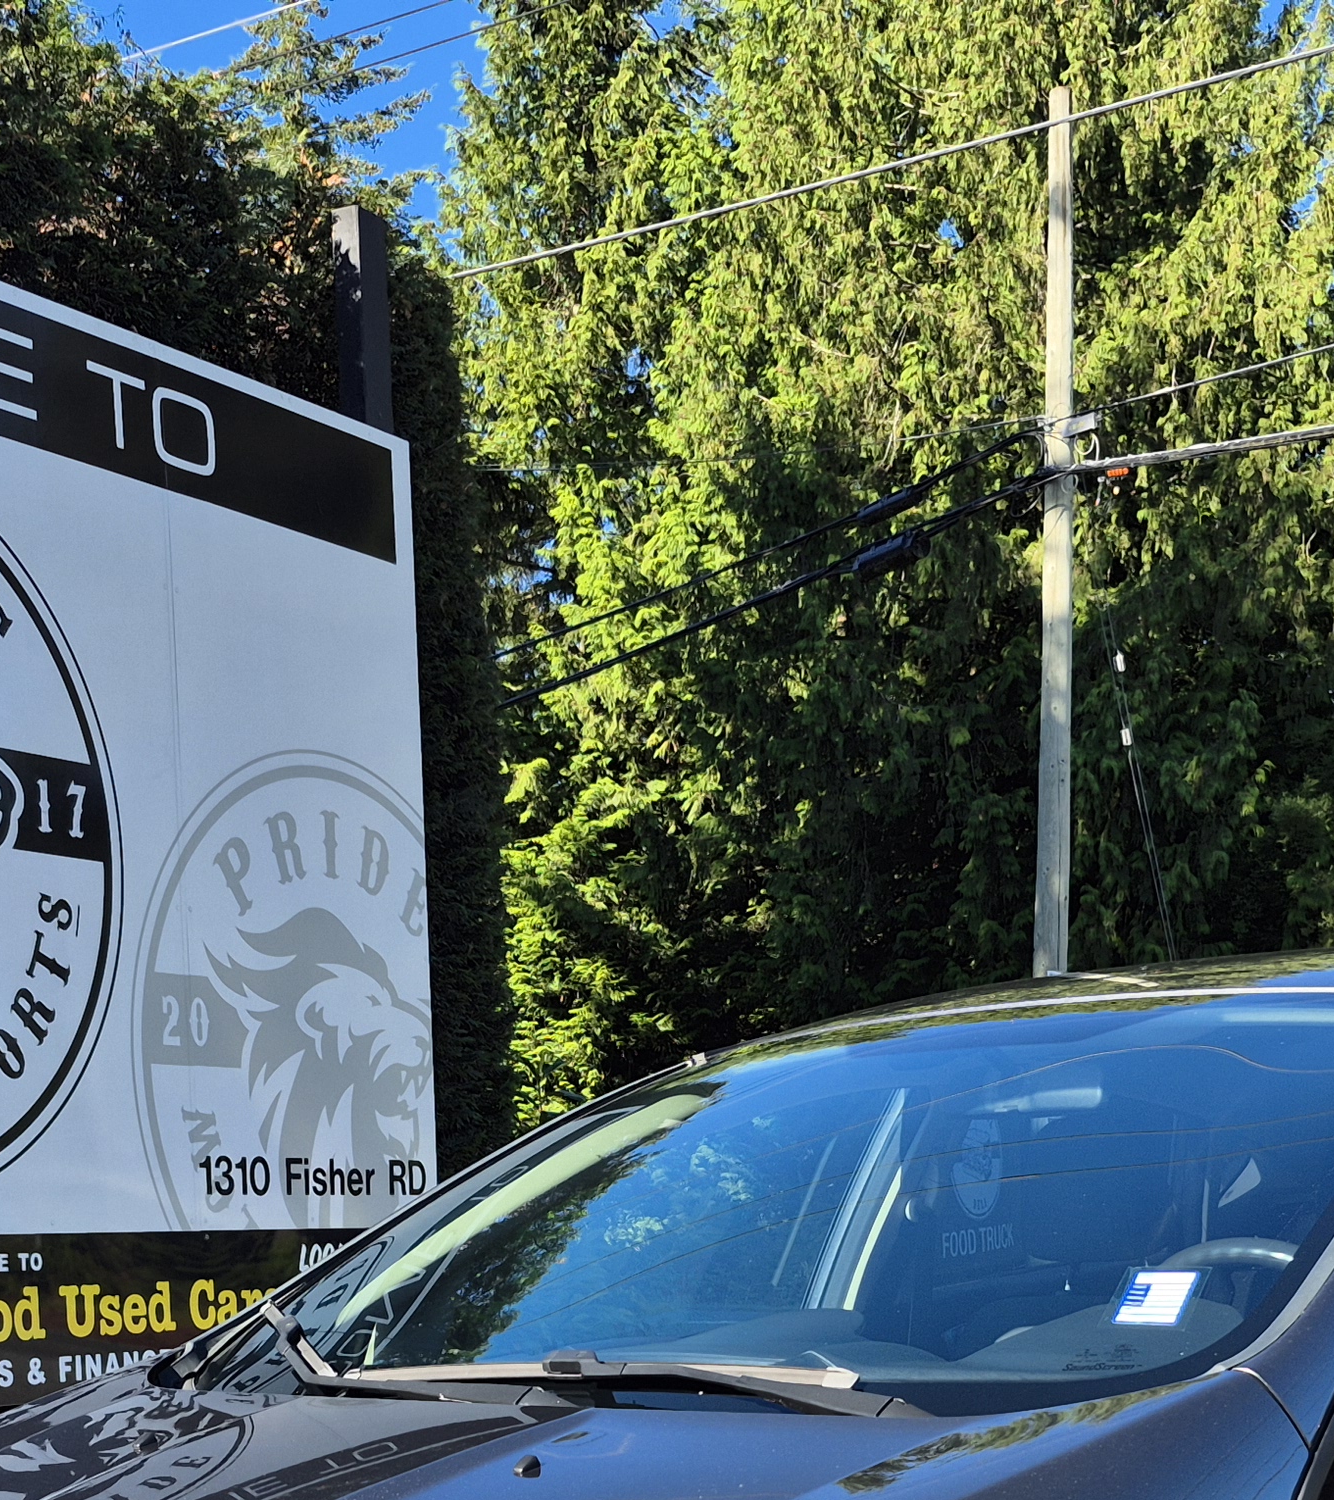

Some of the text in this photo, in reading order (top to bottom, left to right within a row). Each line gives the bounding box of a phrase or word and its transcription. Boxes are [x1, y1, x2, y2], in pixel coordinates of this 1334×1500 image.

[85, 359, 216, 477] TO
[37, 777, 87, 839] 17
[161, 995, 210, 1047] 20
[198, 1155, 427, 1196] 1310 Fisher RD
[17, 1252, 43, 1272] TO
[942, 1223, 1015, 1258] FOOD TRUCK
[58, 1280, 177, 1338] Used
[189, 1278, 276, 1331] Car
[27, 1357, 46, 1386] &
